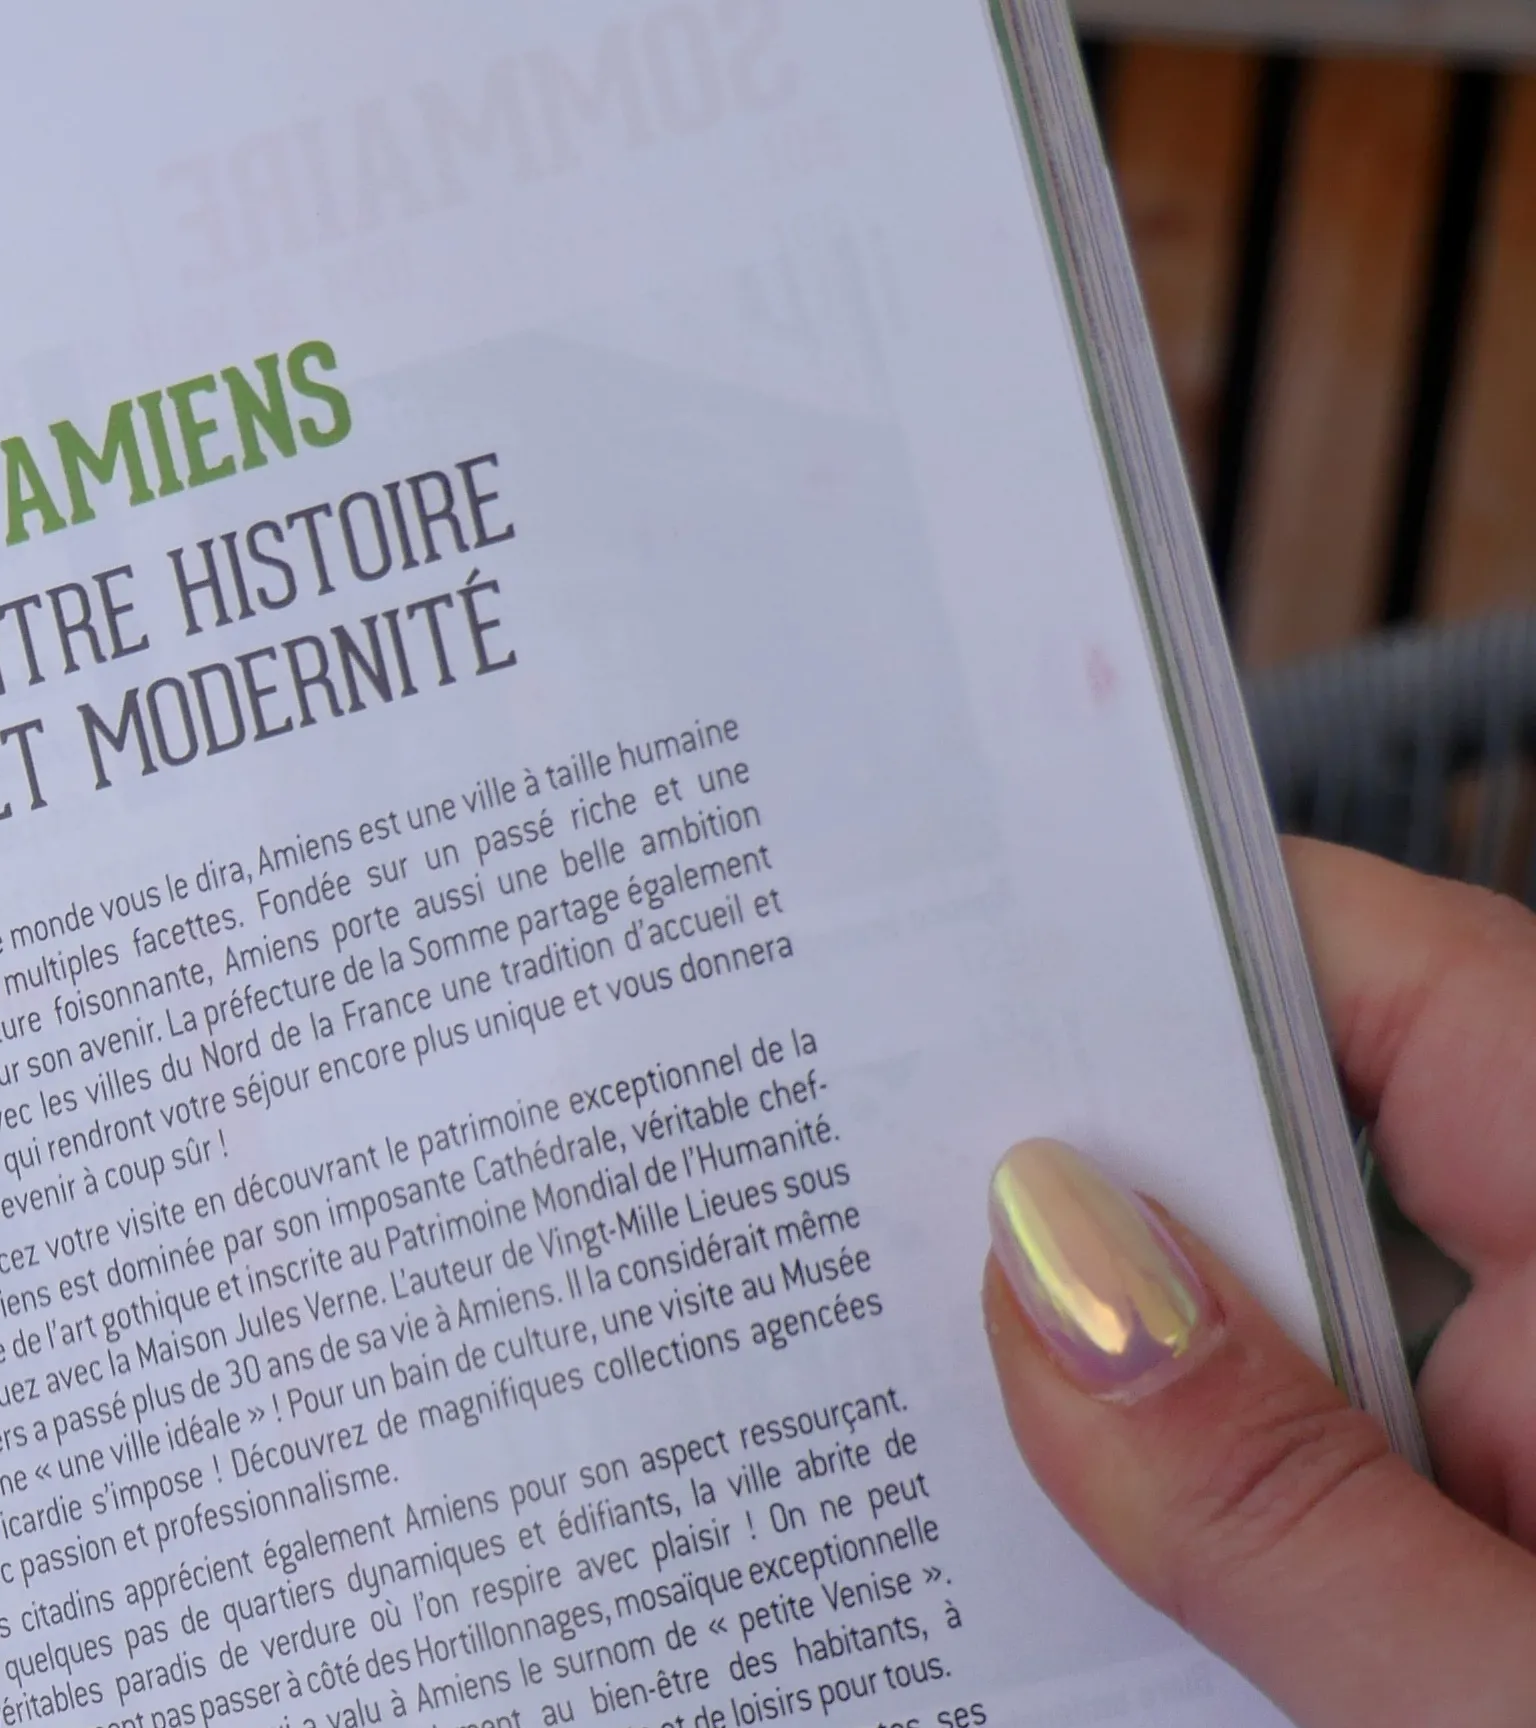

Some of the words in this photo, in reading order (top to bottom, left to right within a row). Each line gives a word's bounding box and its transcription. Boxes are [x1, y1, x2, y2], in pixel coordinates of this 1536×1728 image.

[166, 452, 516, 637] HISTOIRE
[76, 568, 518, 791] MODERNITÉ
[3, 942, 120, 997] multiples
[132, 907, 245, 958] facettes.
[256, 870, 352, 921] Fondée
[366, 856, 408, 889] sur
[423, 843, 460, 871] un
[474, 807, 555, 868] passé
[570, 791, 637, 831] riche
[653, 777, 684, 807] et
[697, 761, 750, 794] une
[44, 1224, 110, 1260] votre
[116, 1200, 186, 1240] visite
[194, 1192, 226, 1219] en
[233, 1144, 381, 1208] découvrant
[384, 1135, 410, 1166] le
[417, 1098, 561, 1167] patrimoine
[569, 1042, 743, 1115] exceptionnel
[751, 1036, 785, 1068] de
[790, 1027, 818, 1058] la
[20, 1588, 115, 1633] citadins
[124, 1549, 255, 1612] apprécient
[263, 1513, 396, 1576] également
[406, 1489, 500, 1535] Amiens
[508, 1471, 567, 1517] pour
[579, 1458, 630, 1490] son
[639, 1429, 730, 1477] aspect
[739, 1386, 908, 1451] ressourçant.
